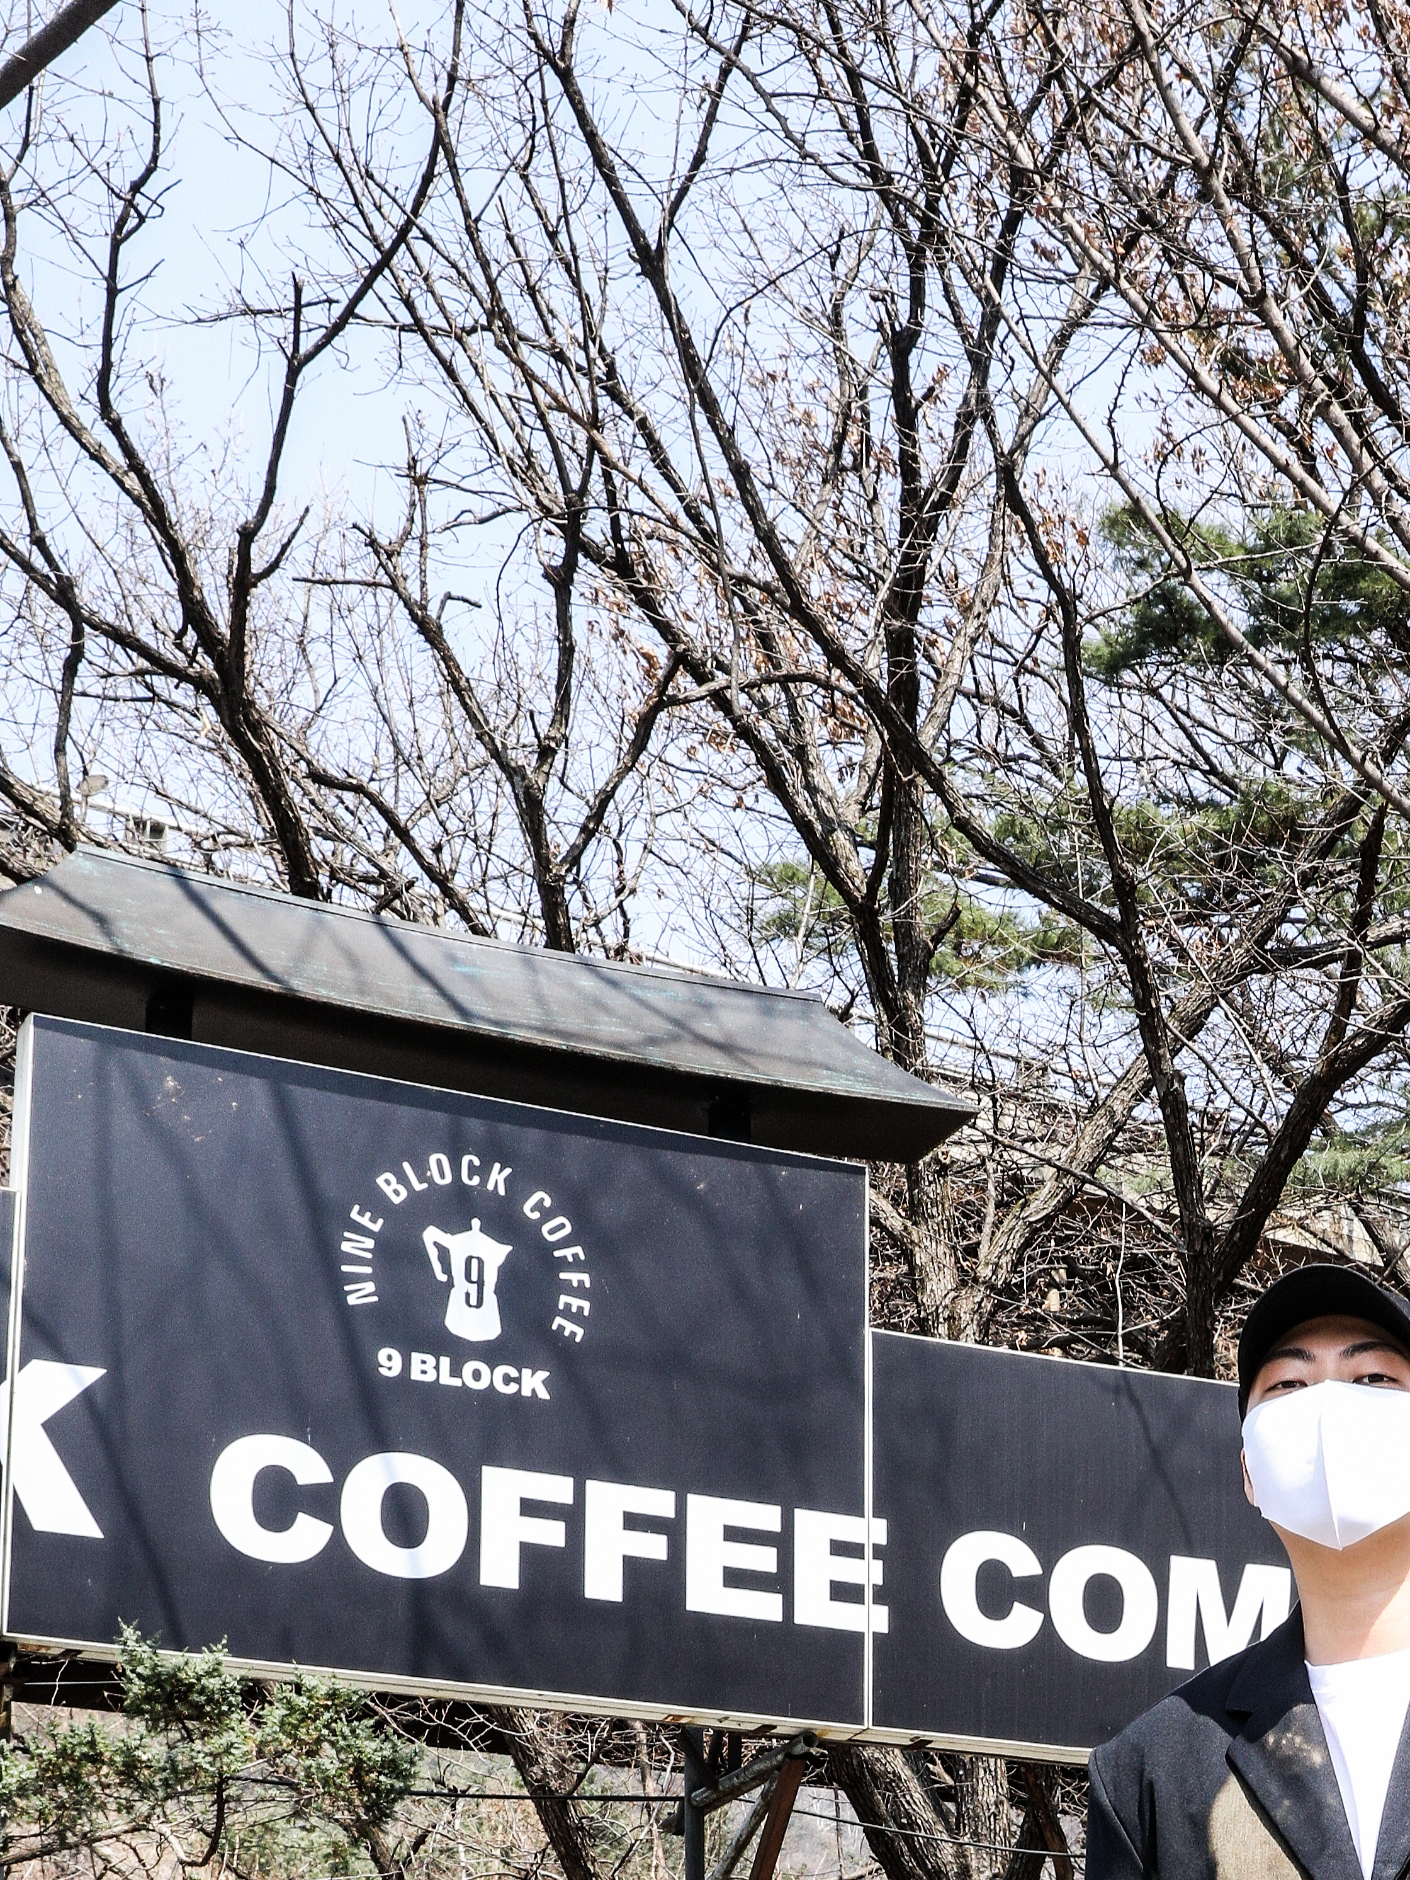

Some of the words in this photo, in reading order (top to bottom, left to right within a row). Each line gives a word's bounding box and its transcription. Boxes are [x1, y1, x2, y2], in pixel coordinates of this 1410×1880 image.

[340, 1204, 384, 1306] NINE
[376, 1152, 513, 1205] BLOCK
[522, 1190, 591, 1343] COFFEE
[463, 1254, 485, 1309] 9
[377, 1347, 403, 1378] 9
[410, 1351, 551, 1400] BLOCK
[209, 1433, 890, 1635] COFFEE
